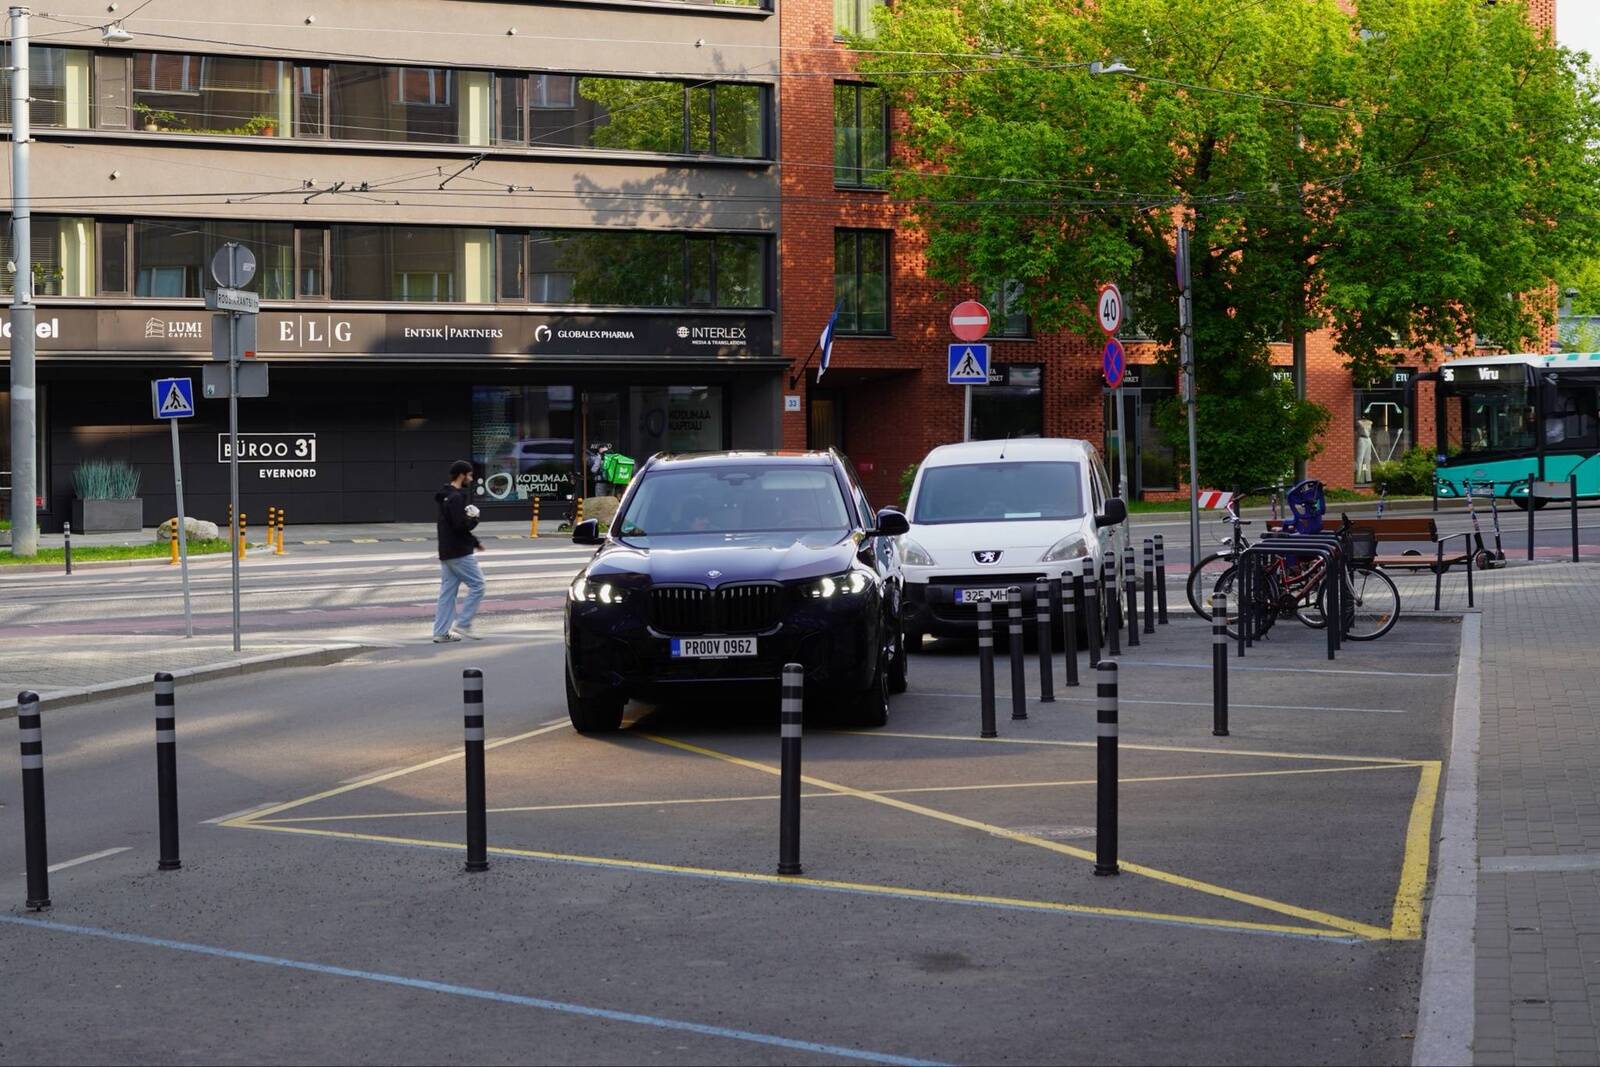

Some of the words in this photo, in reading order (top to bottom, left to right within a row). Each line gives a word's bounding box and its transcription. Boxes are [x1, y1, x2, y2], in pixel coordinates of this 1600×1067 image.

[1103, 298, 1117, 321] 40
[168, 321, 203, 332] LUMI
[557, 329, 601, 339] GLOBALEX
[601, 330, 635, 339] PHARMA
[692, 327, 747, 339] INTERLEX
[1478, 367, 1499, 380] Viru
[788, 399, 797, 407] 33
[224, 440, 288, 457] BÜROO
[294, 438, 316, 462] 31
[259, 468, 317, 478] EVERNORD
[516, 474, 569, 483] KODUMAA
[516, 483, 559, 492] KAPITALI
[989, 589, 1008, 601] MH
[685, 640, 720, 656] PROOV
[723, 639, 752, 655] 0962
